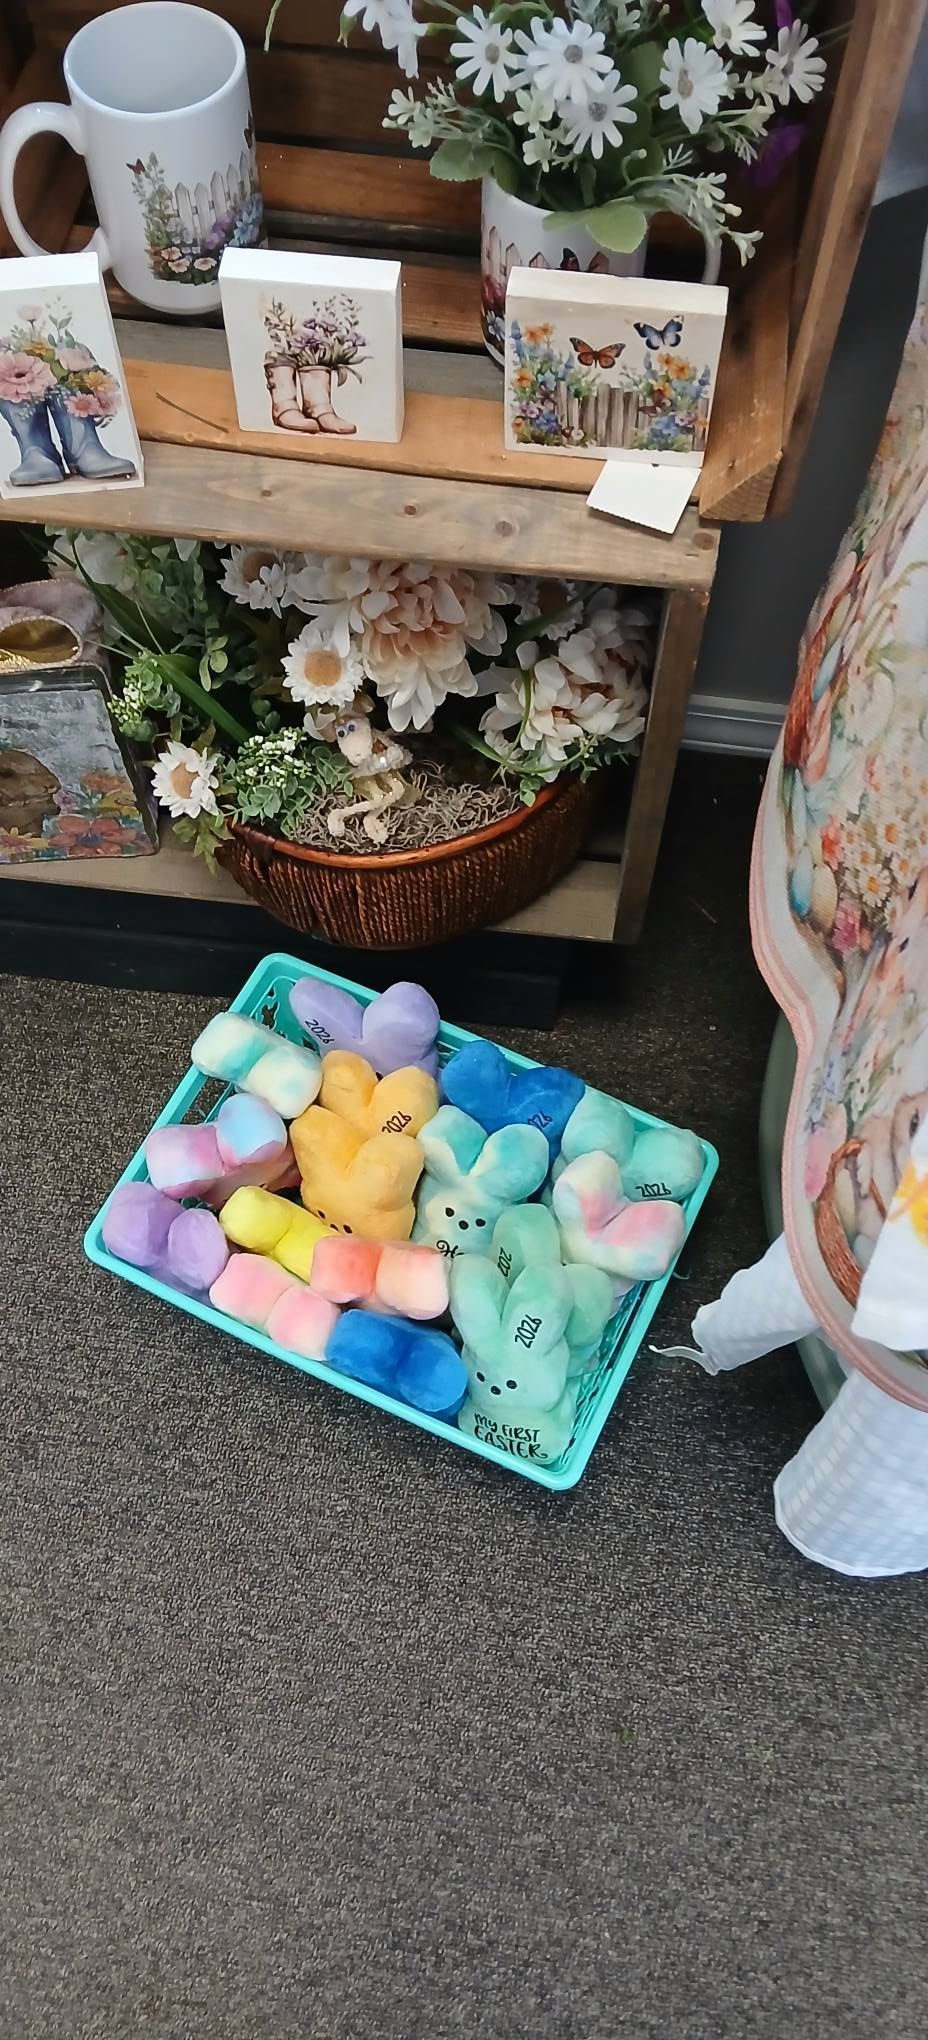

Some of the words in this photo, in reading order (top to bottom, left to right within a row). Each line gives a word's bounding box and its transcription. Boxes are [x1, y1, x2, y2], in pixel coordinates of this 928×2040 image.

[304, 1018, 335, 1045] 2026
[527, 1110, 553, 1131] 026
[635, 1182, 672, 1198] 2026
[497, 1246, 512, 1278] 202
[514, 1314, 543, 1349] 2026
[474, 1425, 548, 1459] EASTER
[502, 1424, 540, 1443] FIRST
